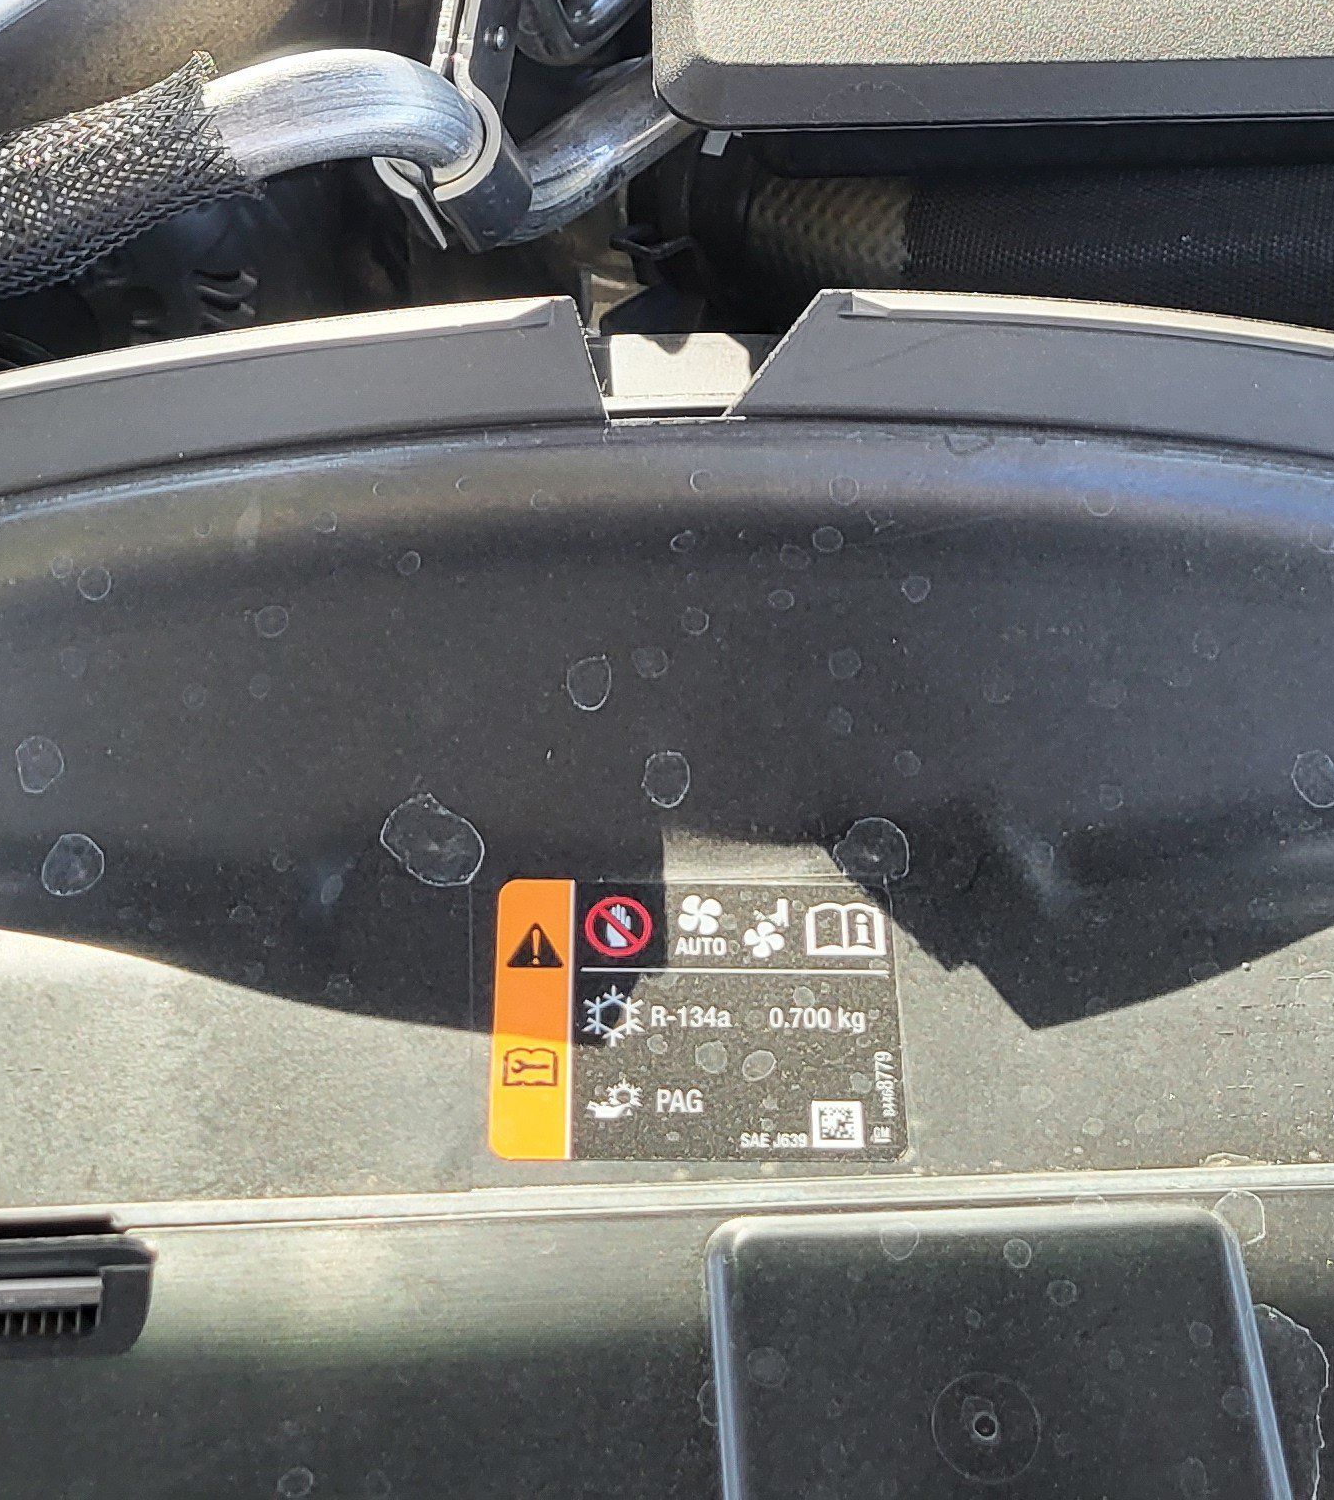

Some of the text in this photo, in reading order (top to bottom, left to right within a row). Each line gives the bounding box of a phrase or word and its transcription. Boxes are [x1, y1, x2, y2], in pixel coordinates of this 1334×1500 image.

[674, 936, 727, 956] AUTO
[651, 1005, 867, 1034] R-134a 0.700 kg
[656, 1088, 704, 1113] PAG
[740, 1132, 808, 1148] SAE J639
